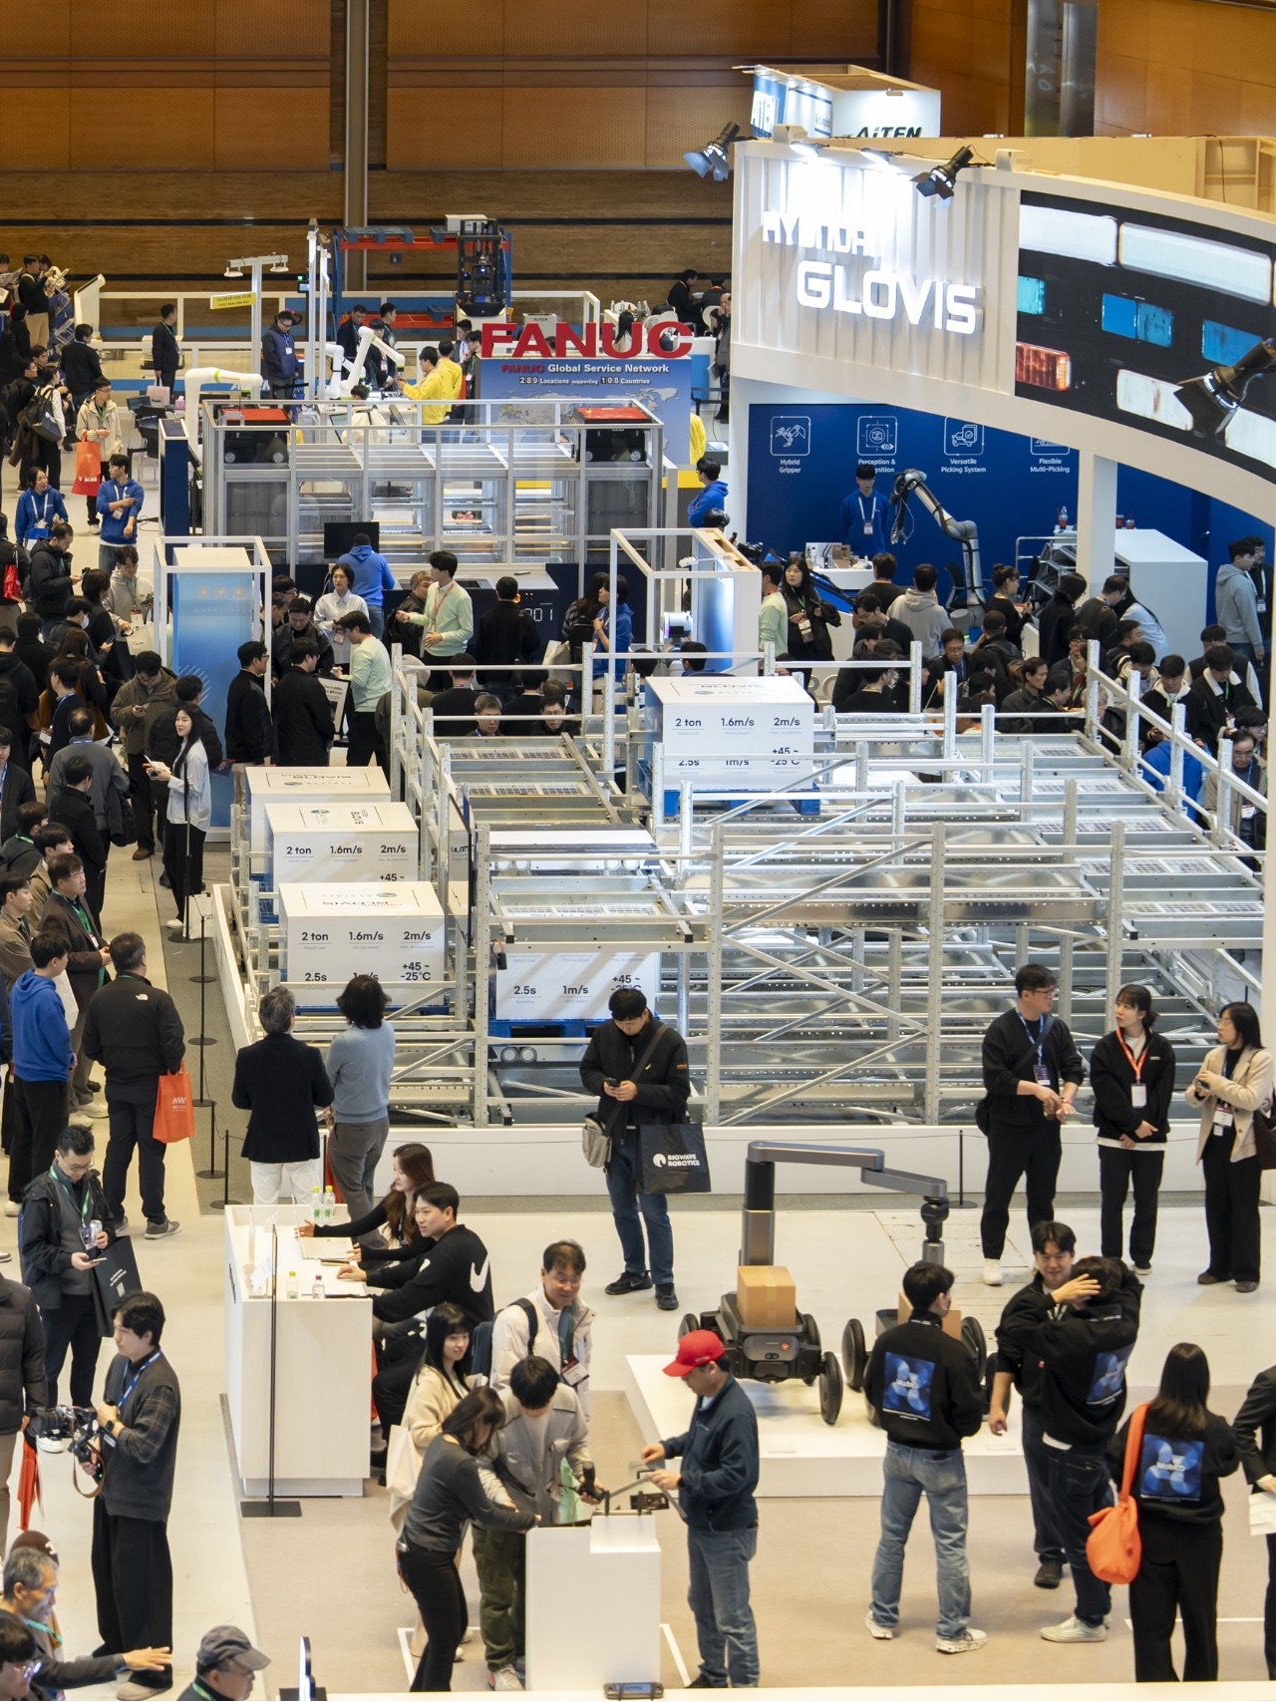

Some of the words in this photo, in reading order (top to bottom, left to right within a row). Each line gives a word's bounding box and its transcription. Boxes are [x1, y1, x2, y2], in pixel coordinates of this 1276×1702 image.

[797, 260, 984, 335] GLOVIS
[480, 320, 693, 360] FANUC
[501, 364, 545, 374] FANUC
[547, 364, 582, 374] Global
[583, 364, 622, 374] Service
[625, 364, 670, 374] Network
[539, 377, 570, 385] Locations
[620, 377, 650, 385] Countries
[780, 458, 800, 467] Hybrid
[857, 458, 888, 467] Perception
[950, 457, 978, 466] Versatile
[1038, 457, 1062, 466] Flexible
[778, 466, 802, 475] Gripper
[940, 466, 964, 475] Picking
[965, 466, 987, 475] System
[1029, 466, 1071, 475] Multi-Picking
[675, 718, 682, 727] 2
[685, 718, 702, 727] ton
[720, 717, 755, 727] 1.6m/s
[773, 717, 801, 726] 2m/s
[286, 846, 293, 855] 2
[295, 846, 312, 855] ton
[330, 845, 362, 854] 1.6m/s
[380, 845, 406, 854] 2m/s
[379, 873, 397, 882] +45
[301, 931, 308, 941] 2
[310, 931, 329, 941] ton
[348, 931, 384, 941] 1.6m/s
[403, 931, 432, 940] 2m/s
[402, 962, 422, 971] +45
[304, 972, 327, 982] 2.5s
[400, 971, 431, 981] -25°C
[612, 975, 632, 984] +45
[513, 985, 537, 995] 2.5s
[562, 985, 589, 995] 1m/s
